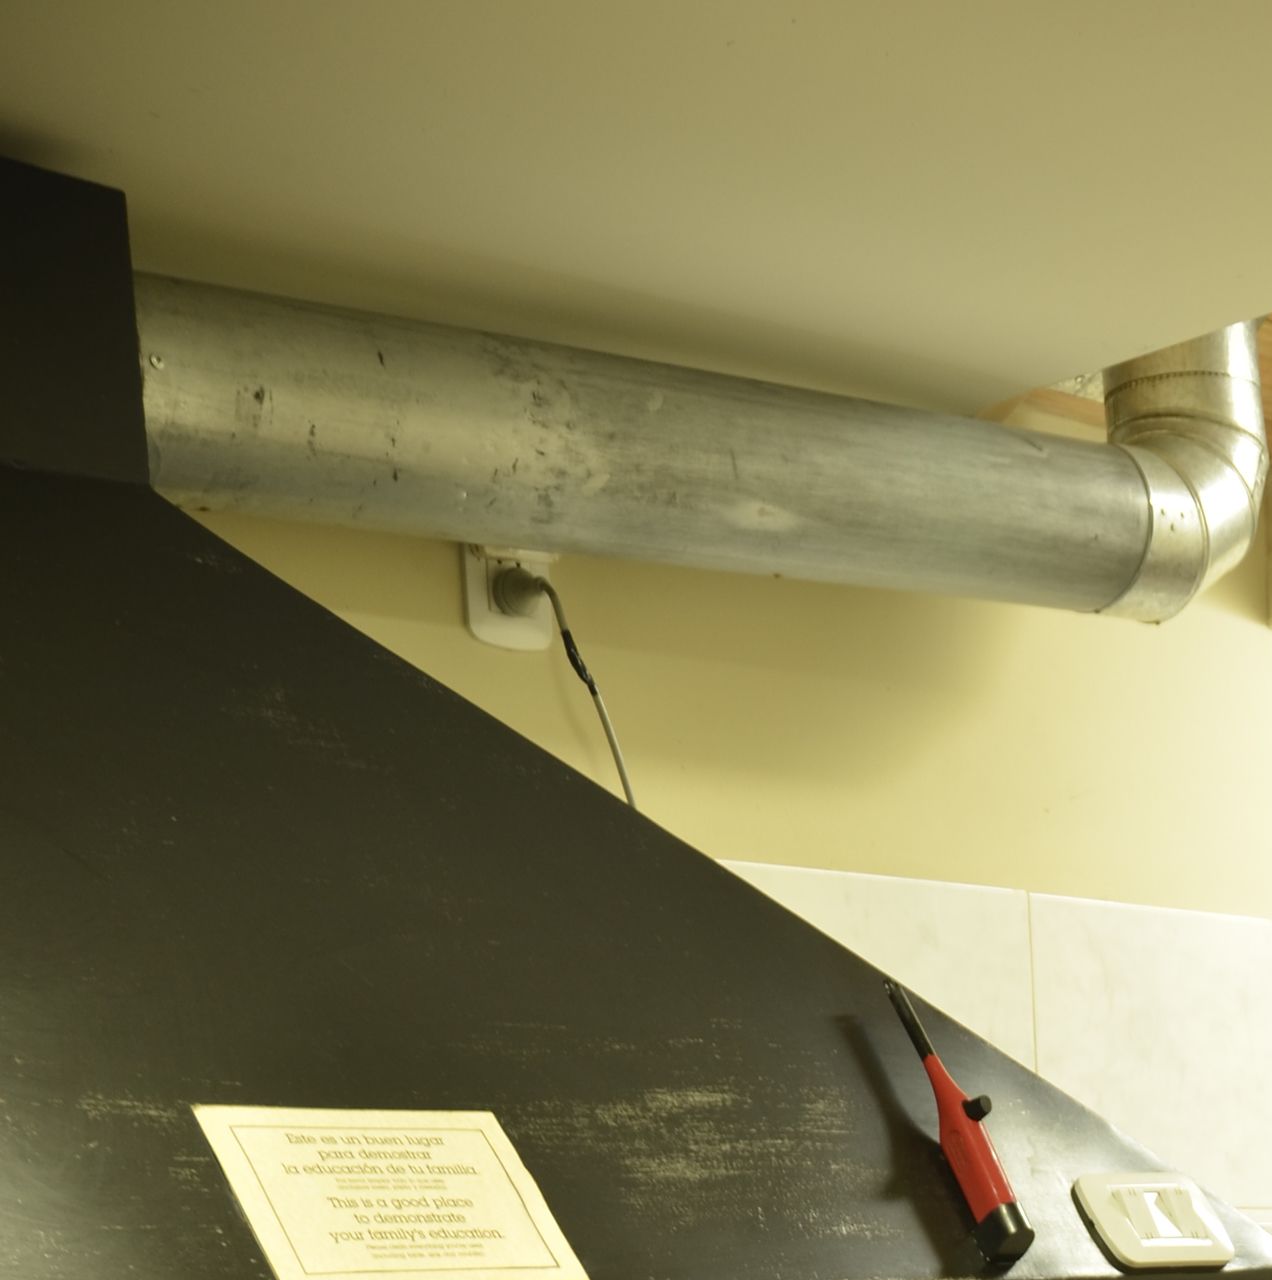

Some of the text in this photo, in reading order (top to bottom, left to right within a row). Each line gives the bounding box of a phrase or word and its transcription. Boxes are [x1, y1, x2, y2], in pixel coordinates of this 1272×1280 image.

[285, 1133, 446, 1148] Este es un buen lugar
[318, 1149, 433, 1162] para demostrar
[281, 1162, 300, 1175] la
[303, 1162, 384, 1175] educación
[386, 1163, 407, 1174] de
[408, 1163, 425, 1174] tu
[327, 1196, 475, 1211] This is a good place
[353, 1212, 467, 1225] to demonstrate
[329, 1231, 365, 1244] your
[367, 1229, 426, 1242] family's
